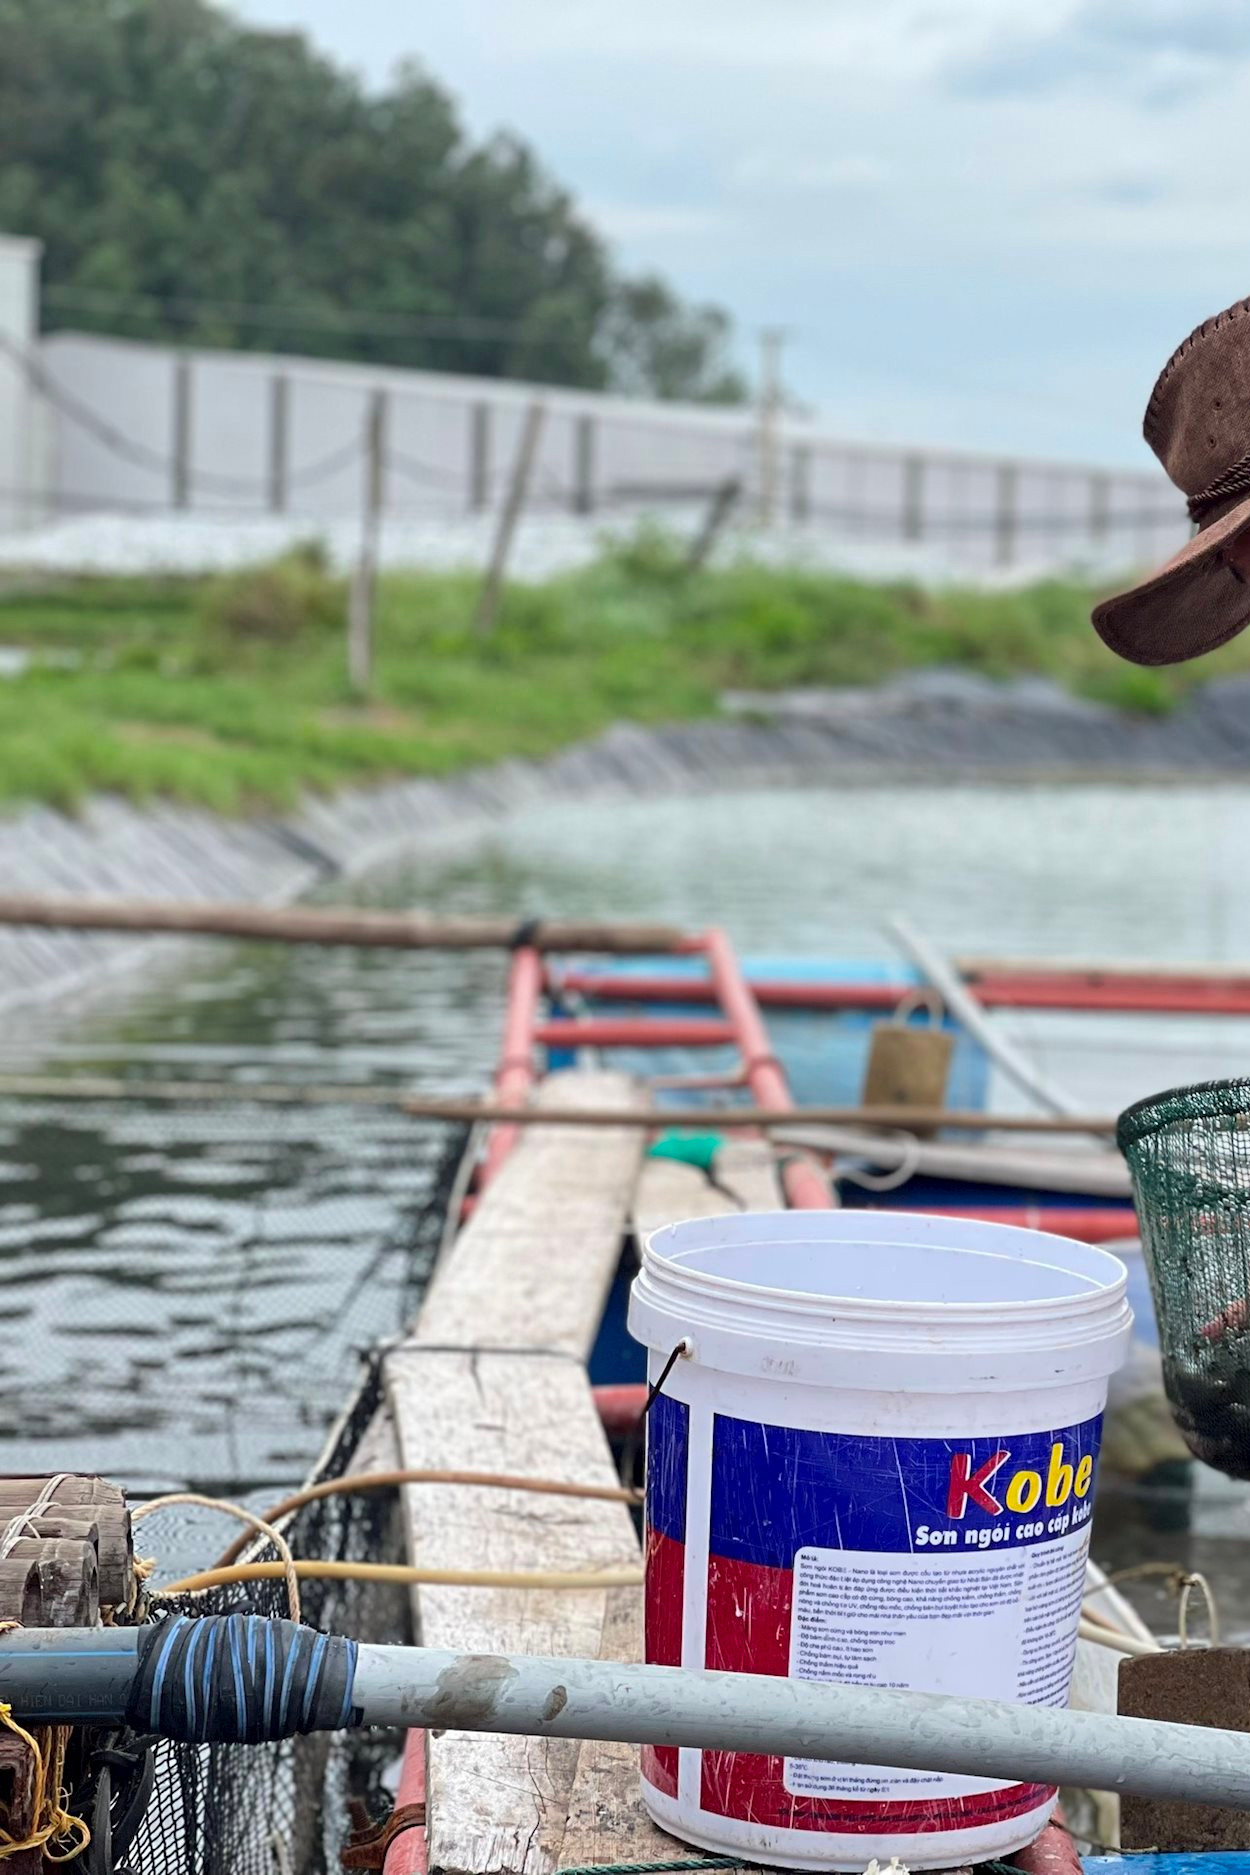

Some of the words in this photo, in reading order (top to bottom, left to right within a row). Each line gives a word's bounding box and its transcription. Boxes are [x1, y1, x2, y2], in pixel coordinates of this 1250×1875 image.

[947, 1442, 1092, 1519] Kobe
[915, 1525, 957, 1546] Sơn
[965, 1521, 1010, 1548] ngói
[1015, 1522, 1044, 1539] cao
[1048, 1510, 1069, 1534] cấp
